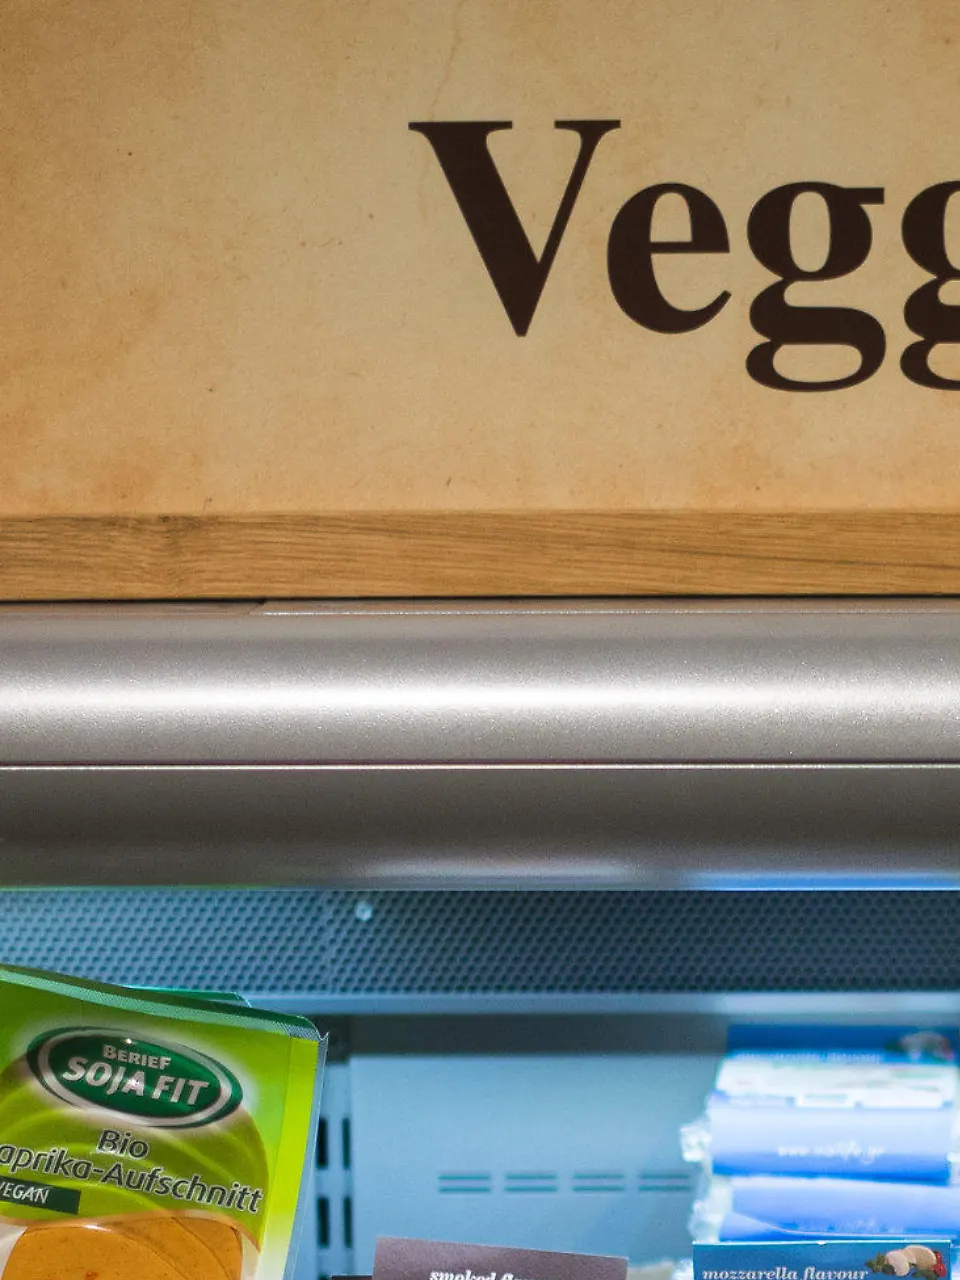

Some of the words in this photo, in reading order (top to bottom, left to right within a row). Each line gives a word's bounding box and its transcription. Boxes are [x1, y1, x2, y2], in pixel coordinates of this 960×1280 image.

[102, 1044, 171, 1071] BERIEF
[62, 1056, 147, 1098] SOJA
[151, 1076, 209, 1106] FIT
[97, 1129, 149, 1160] Bio
[702, 1266, 798, 1280] mozzarella
